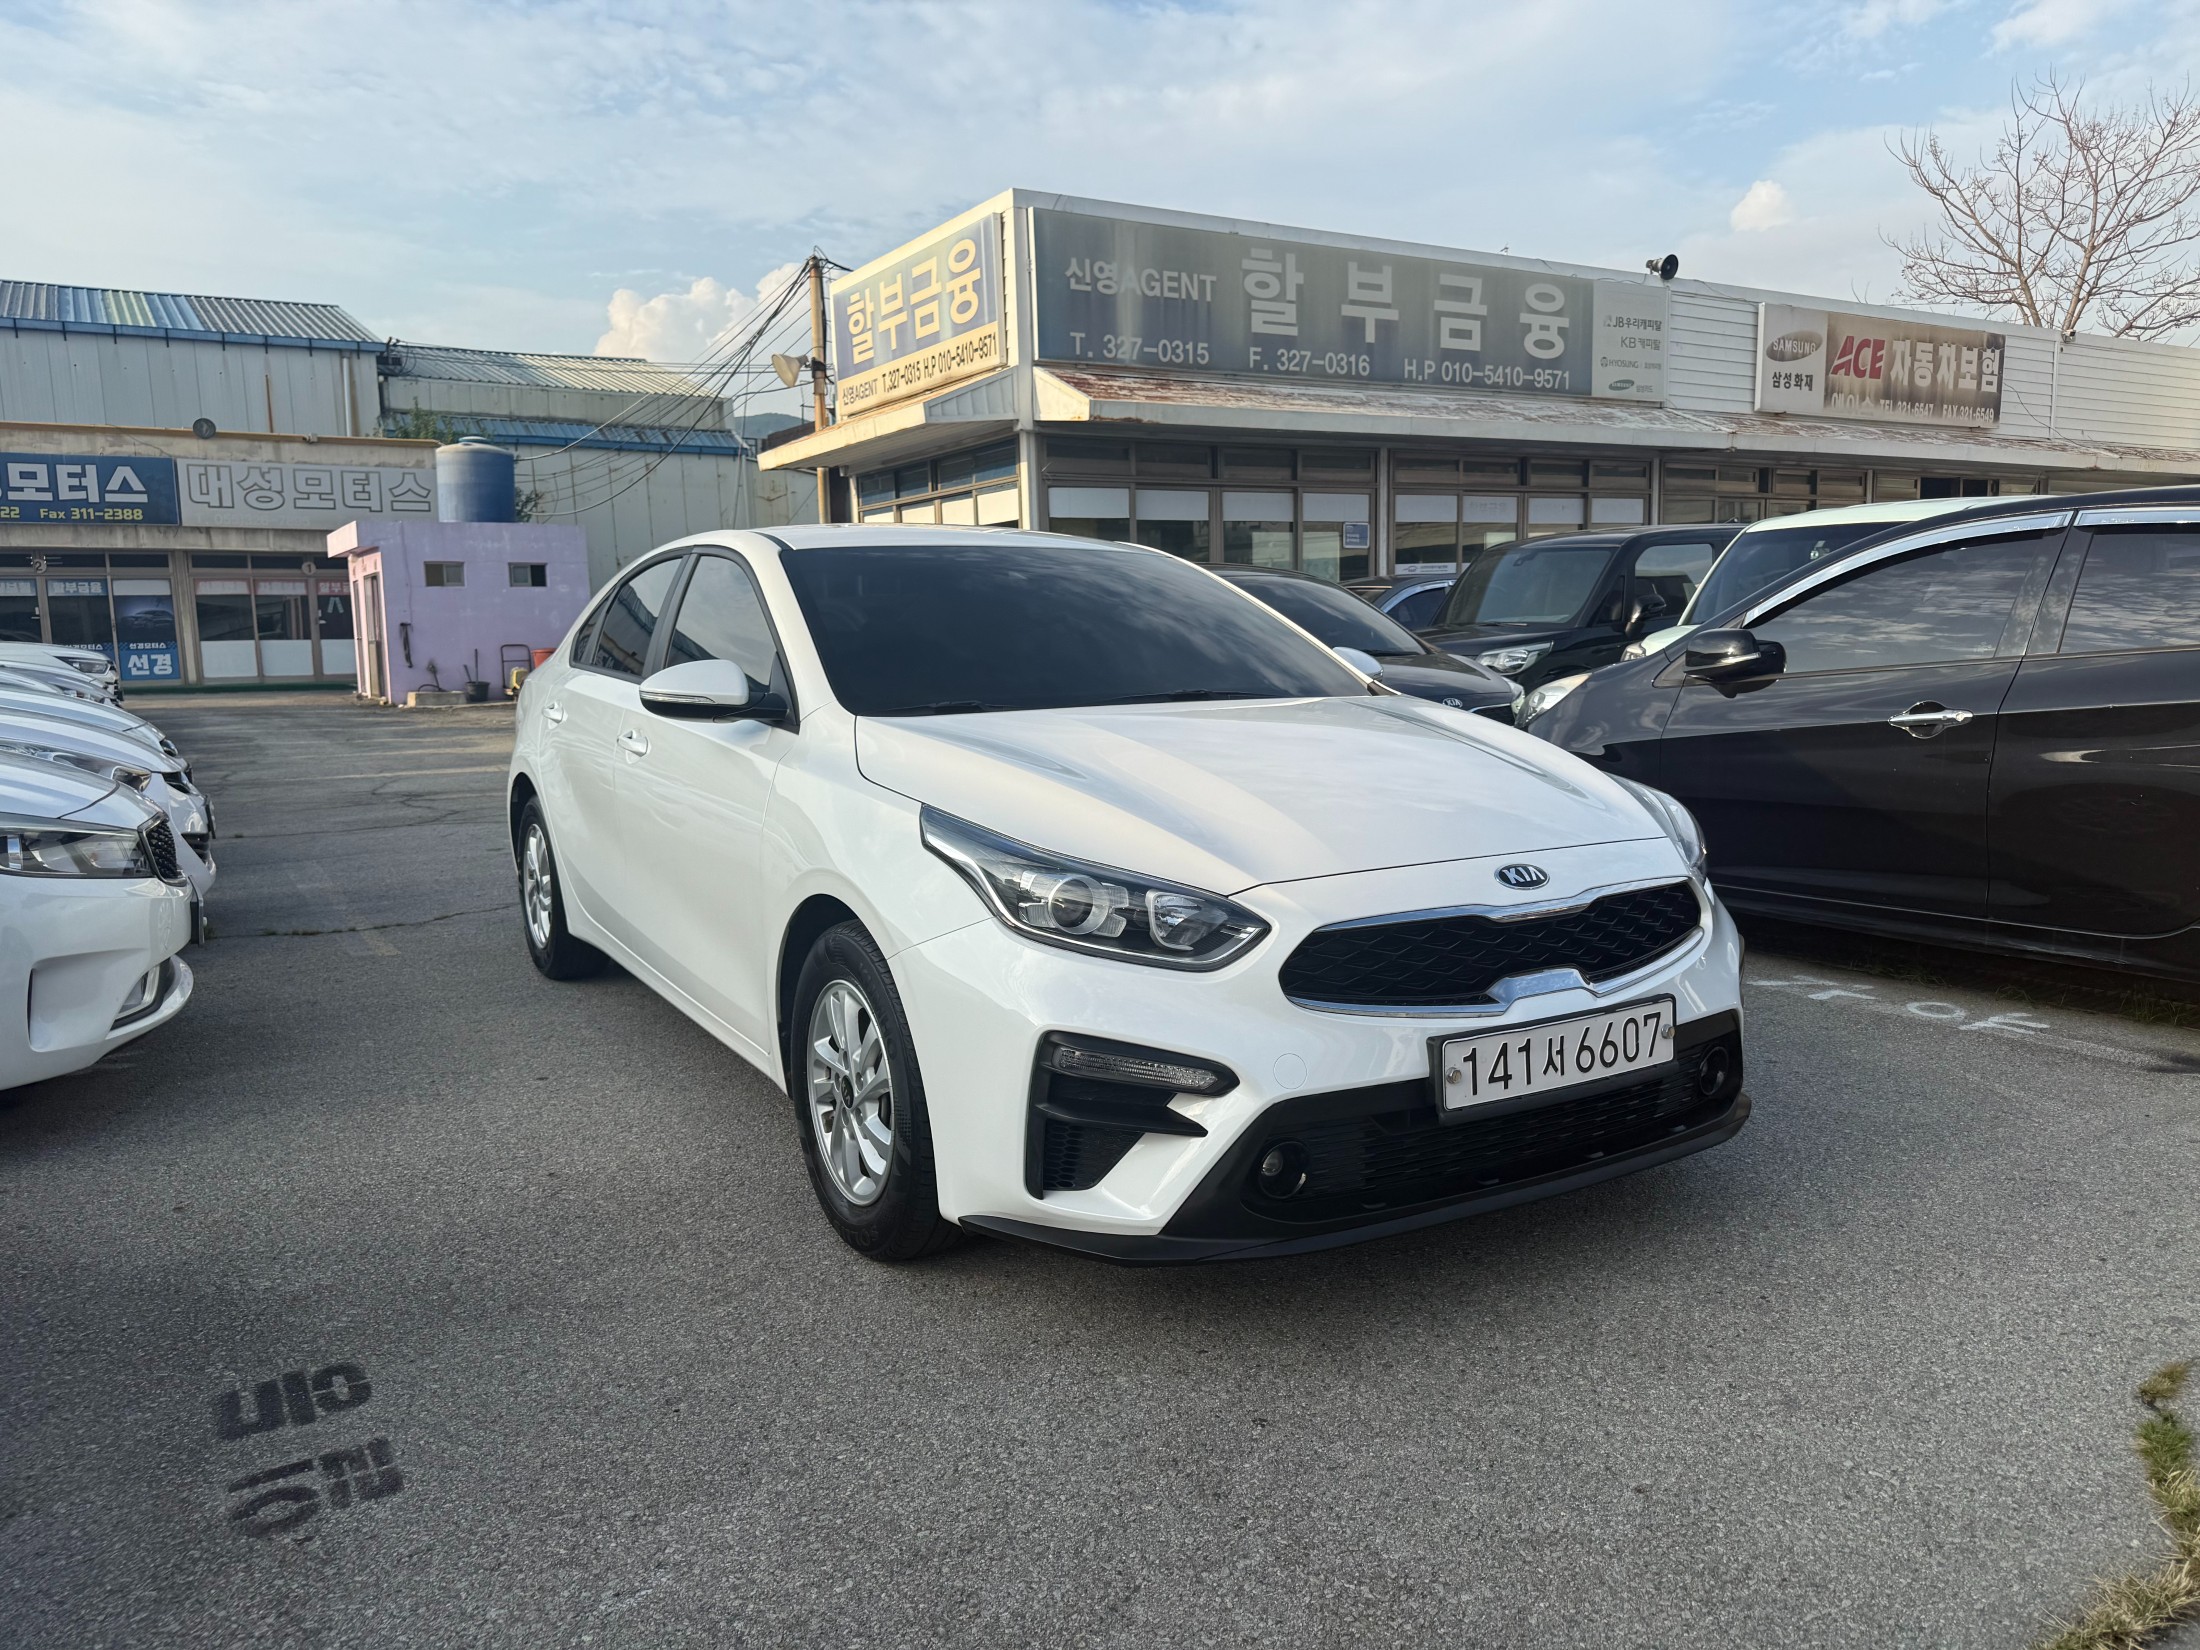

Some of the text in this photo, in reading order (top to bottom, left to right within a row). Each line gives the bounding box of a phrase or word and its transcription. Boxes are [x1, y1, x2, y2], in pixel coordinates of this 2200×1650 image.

[1065, 257, 1217, 302] 신영AGENT
[847, 239, 981, 364] 할부금융
[1241, 248, 1570, 359] 할부금융
[938, 331, 997, 374] 010-5410-9571
[1103, 334, 1210, 364] 327-0315
[1276, 349, 1370, 376] 327-0316
[1772, 338, 1817, 353] SAMSUNG
[1829, 335, 1886, 379] ACE
[1404, 358, 1570, 390] H.P 010-5410-9571
[1771, 371, 1814, 391] 삼성화재
[1890, 338, 1998, 393] 자동차보험
[0, 462, 148, 503] 모터스
[186, 463, 432, 513] 대성모터스
[40, 508, 66, 519] Fax
[71, 508, 143, 521] 311-2388
[34, 561, 44, 572] 2
[128, 654, 173, 676] 선경
[1502, 864, 1545, 884] KIA
[1462, 1012, 1661, 1096] 141서6607
